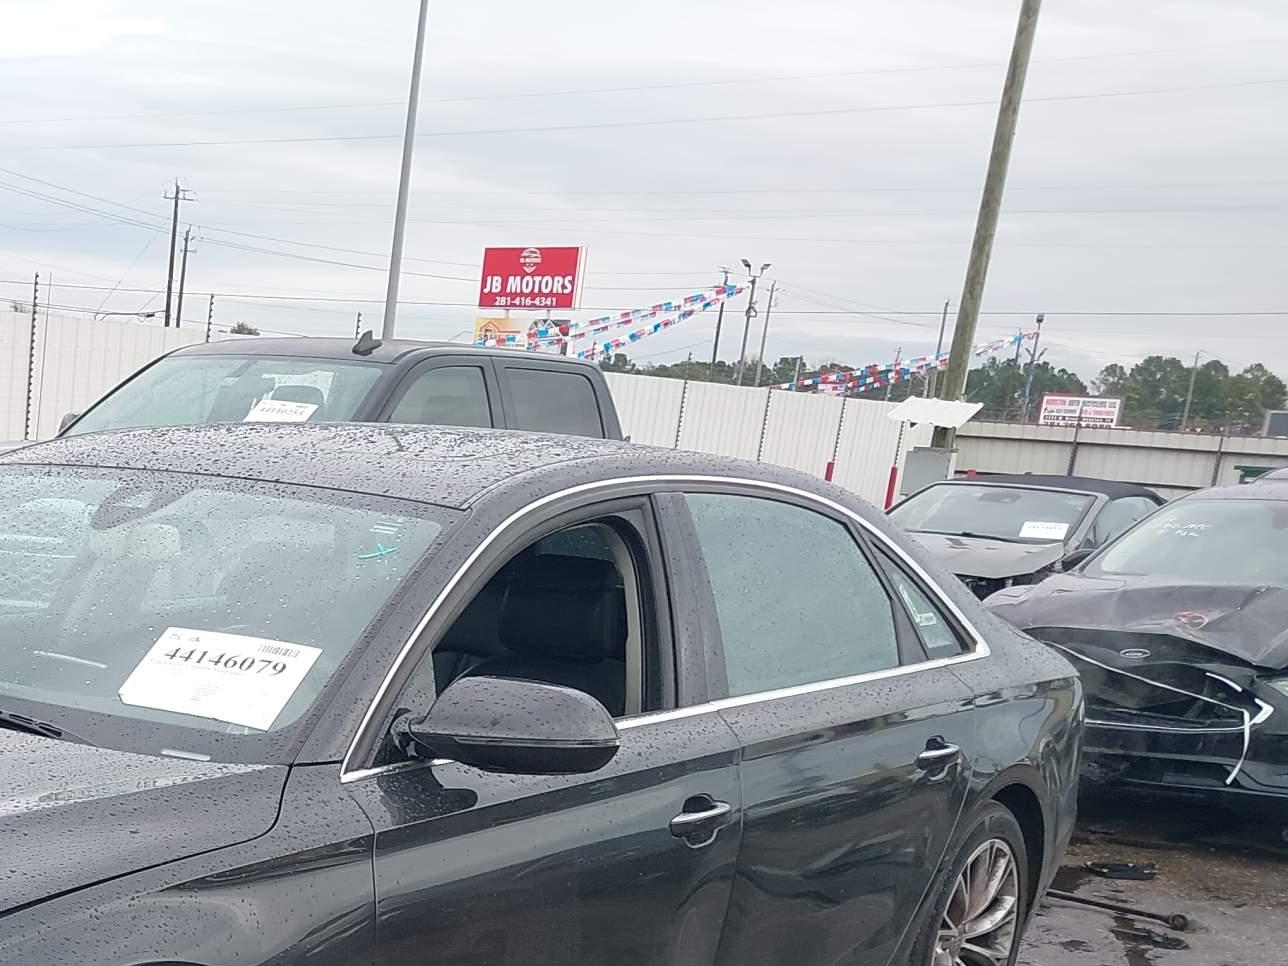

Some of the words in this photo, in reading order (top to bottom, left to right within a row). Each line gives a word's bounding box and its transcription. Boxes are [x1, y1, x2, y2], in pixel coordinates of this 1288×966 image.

[483, 275, 502, 294] JB
[506, 275, 573, 294] MOTORS
[494, 296, 557, 306] 281-416-4341
[164, 647, 287, 676] 44146079
